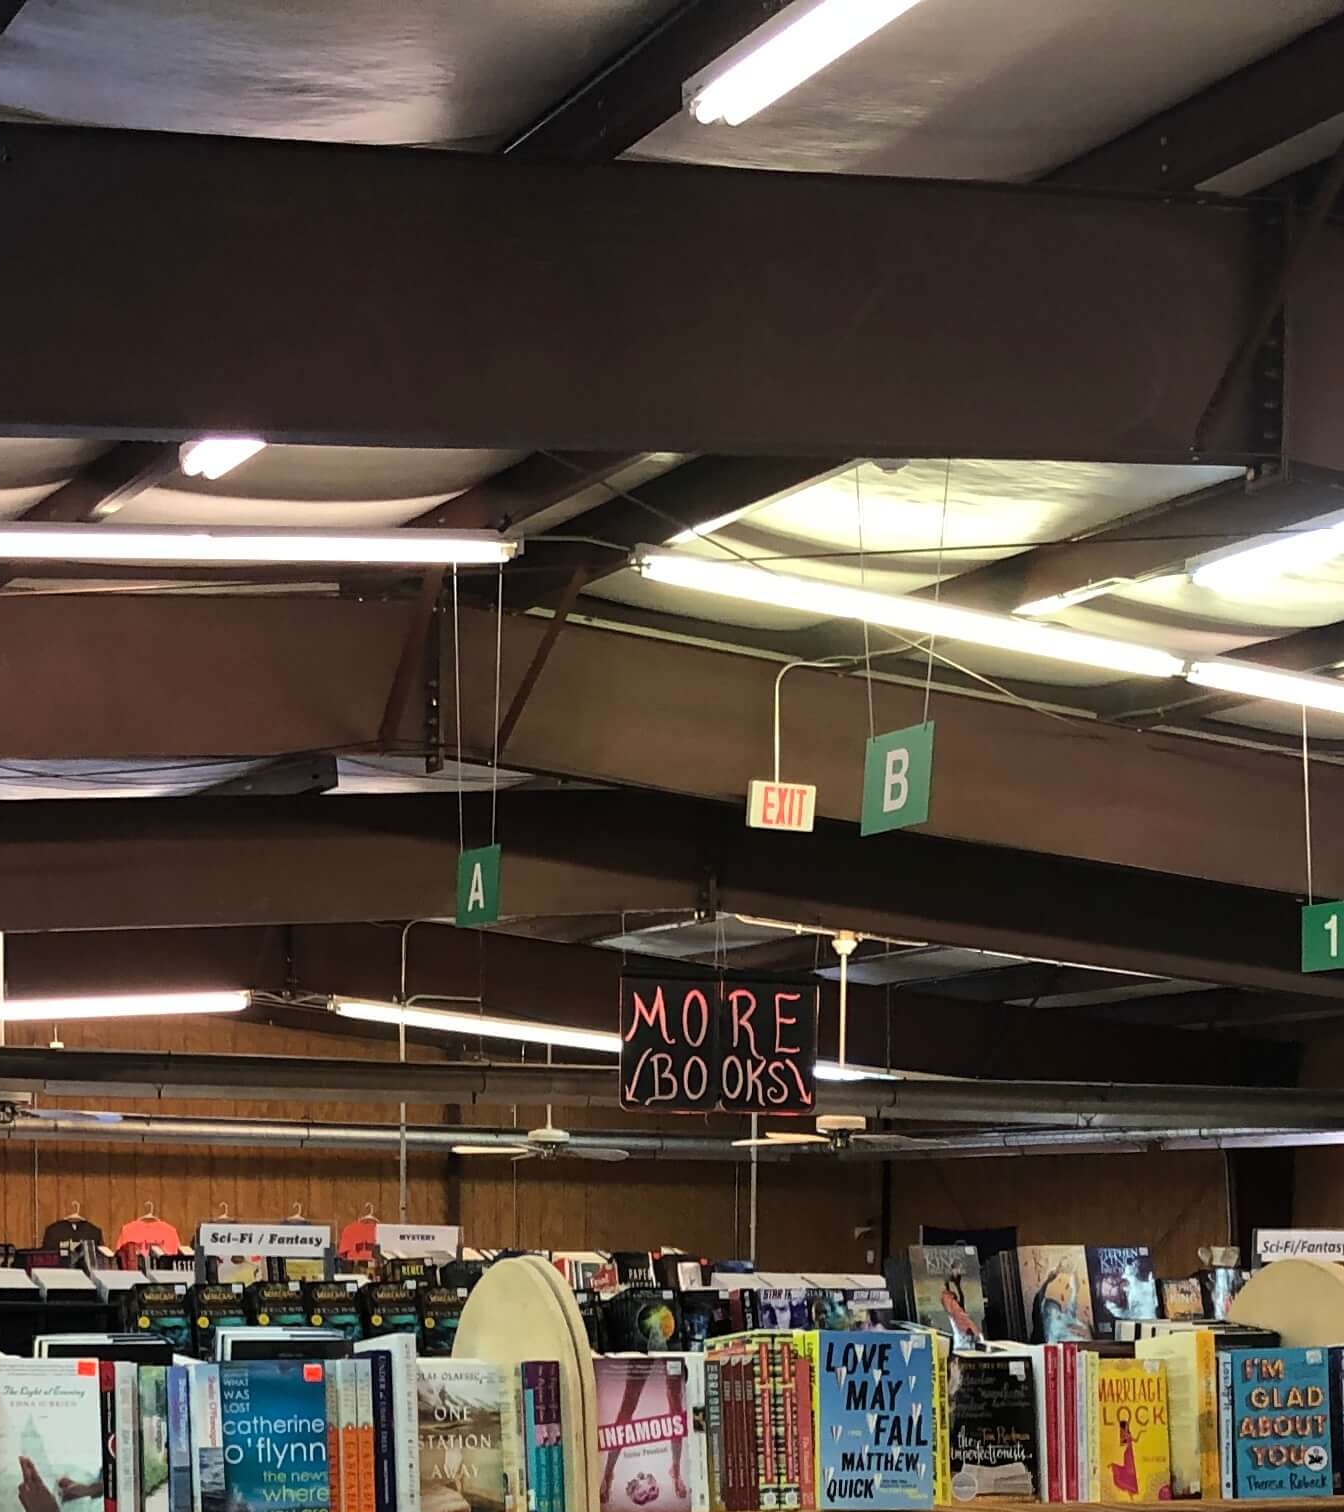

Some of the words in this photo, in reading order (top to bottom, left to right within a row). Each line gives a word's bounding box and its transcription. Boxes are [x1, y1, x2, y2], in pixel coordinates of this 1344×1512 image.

[882, 747, 909, 813] B
[762, 787, 807, 827] EXIT
[467, 864, 484, 912] A
[1324, 914, 1339, 959] 1
[626, 989, 801, 1058] MORE
[645, 1052, 789, 1107] BOOKS
[210, 1232, 253, 1245] Sci-Fi
[269, 1232, 323, 1249] Fantasy
[826, 1343, 891, 1374] LOVE
[1245, 1359, 1284, 1380] I'M
[223, 1378, 249, 1387] WHAT
[223, 1390, 249, 1399] WAS
[846, 1380, 902, 1412] MAY
[1251, 1386, 1323, 1408] GLAD
[224, 1403, 250, 1413] LOST
[223, 1415, 325, 1436] catherine
[598, 1415, 686, 1449] INFAMOUS
[874, 1415, 928, 1448] FAIL
[1240, 1414, 1327, 1437] ABOUT
[225, 1437, 327, 1466] o'flynn
[842, 1453, 919, 1472] MATTHEW
[1255, 1446, 1307, 1467] YOU
[263, 1470, 288, 1483] the
[263, 1486, 328, 1503] where
[827, 1478, 874, 1499] QUICK
